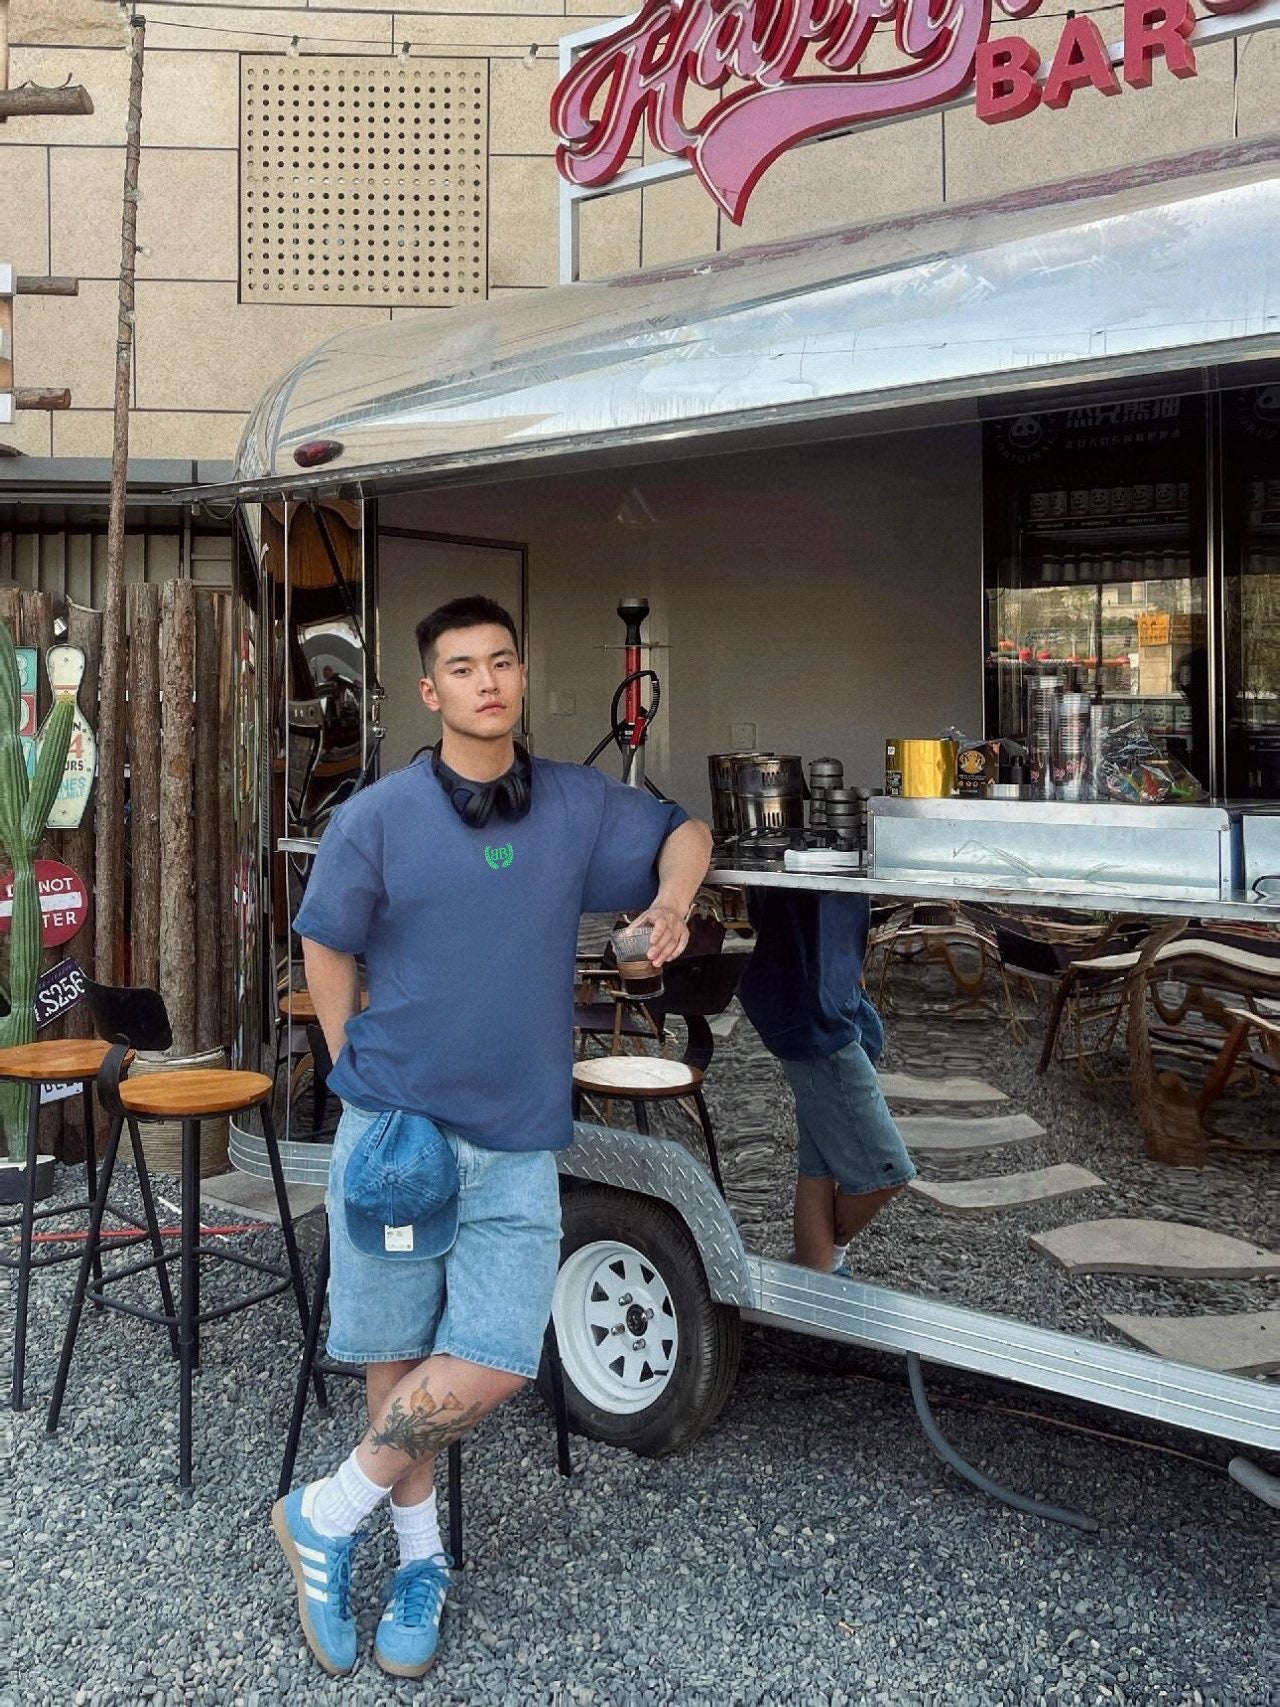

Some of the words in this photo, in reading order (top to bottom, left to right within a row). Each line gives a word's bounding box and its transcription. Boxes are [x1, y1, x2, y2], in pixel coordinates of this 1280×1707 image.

[976, 0, 1197, 125] BAR
[68, 733, 84, 758] 4
[38, 877, 73, 894] NOT
[42, 911, 77, 928] TER
